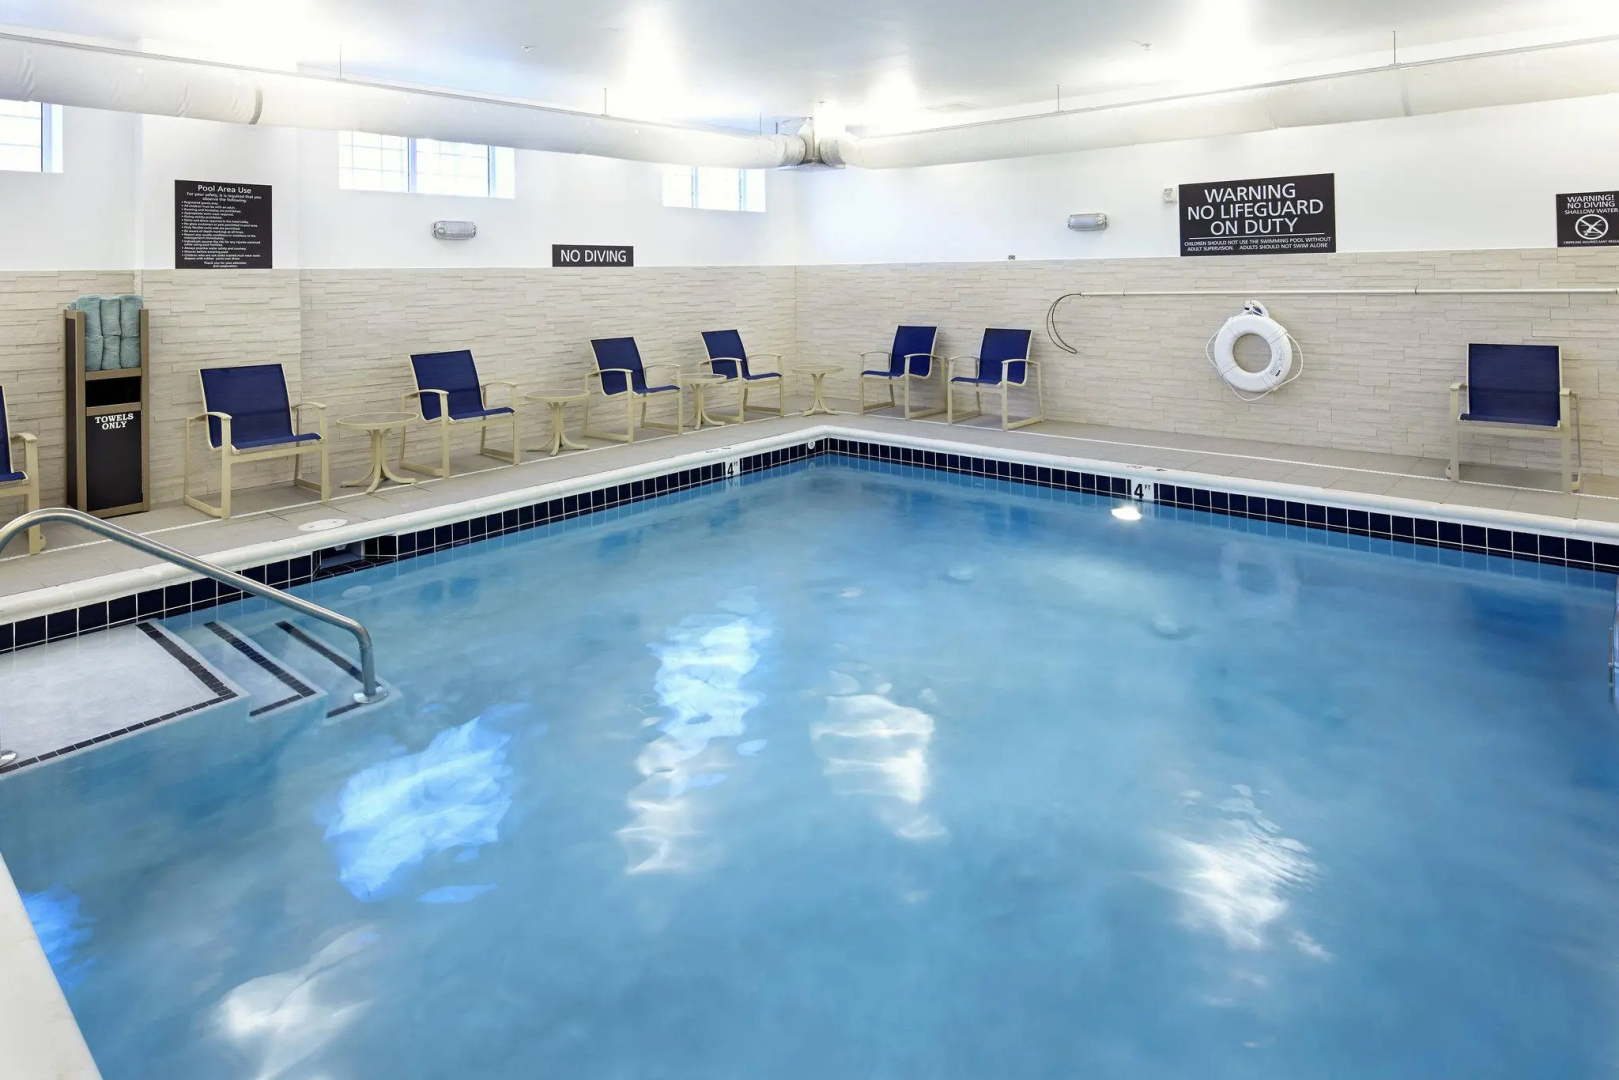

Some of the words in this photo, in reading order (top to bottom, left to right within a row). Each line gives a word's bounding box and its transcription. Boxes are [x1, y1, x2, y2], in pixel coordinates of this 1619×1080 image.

[1204, 183, 1296, 203] WARNING
[1567, 194, 1614, 202] WARNING!
[1188, 206, 1214, 220] NO
[1221, 199, 1323, 219] LIFEGUARD
[1210, 220, 1238, 235] ON
[1245, 217, 1298, 234] DUTY
[560, 250, 580, 262] NO
[584, 250, 626, 262] DIVING
[95, 413, 134, 424] TOWELS
[102, 421, 127, 430] ONLY
[727, 462, 734, 475] 4
[1134, 484, 1144, 499] 4
